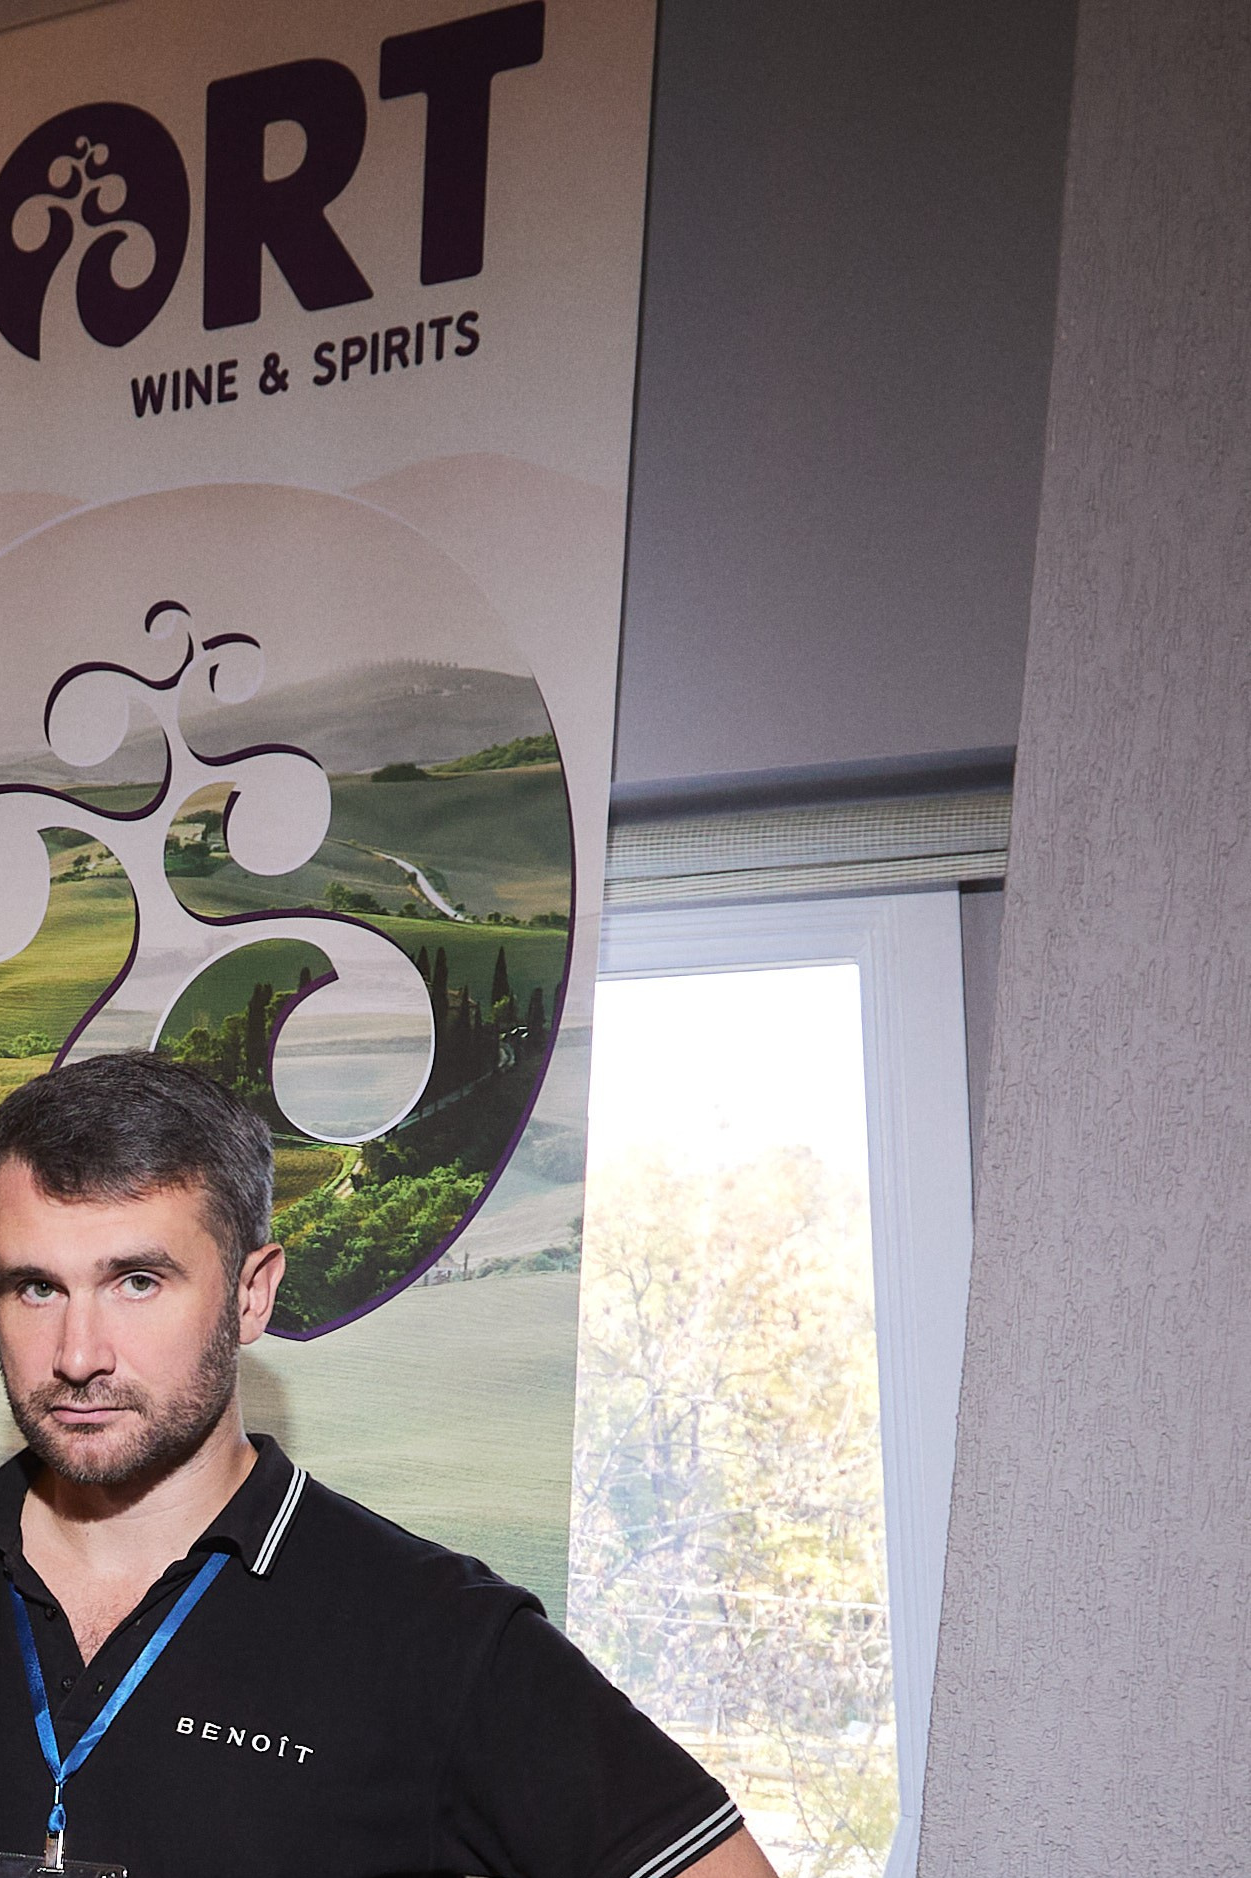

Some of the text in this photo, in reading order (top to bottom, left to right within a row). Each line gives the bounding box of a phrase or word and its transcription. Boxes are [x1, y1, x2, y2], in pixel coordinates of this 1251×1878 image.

[131, 310, 480, 418] WINE & SPIRITS
[176, 1716, 314, 1764] BENOÎT
